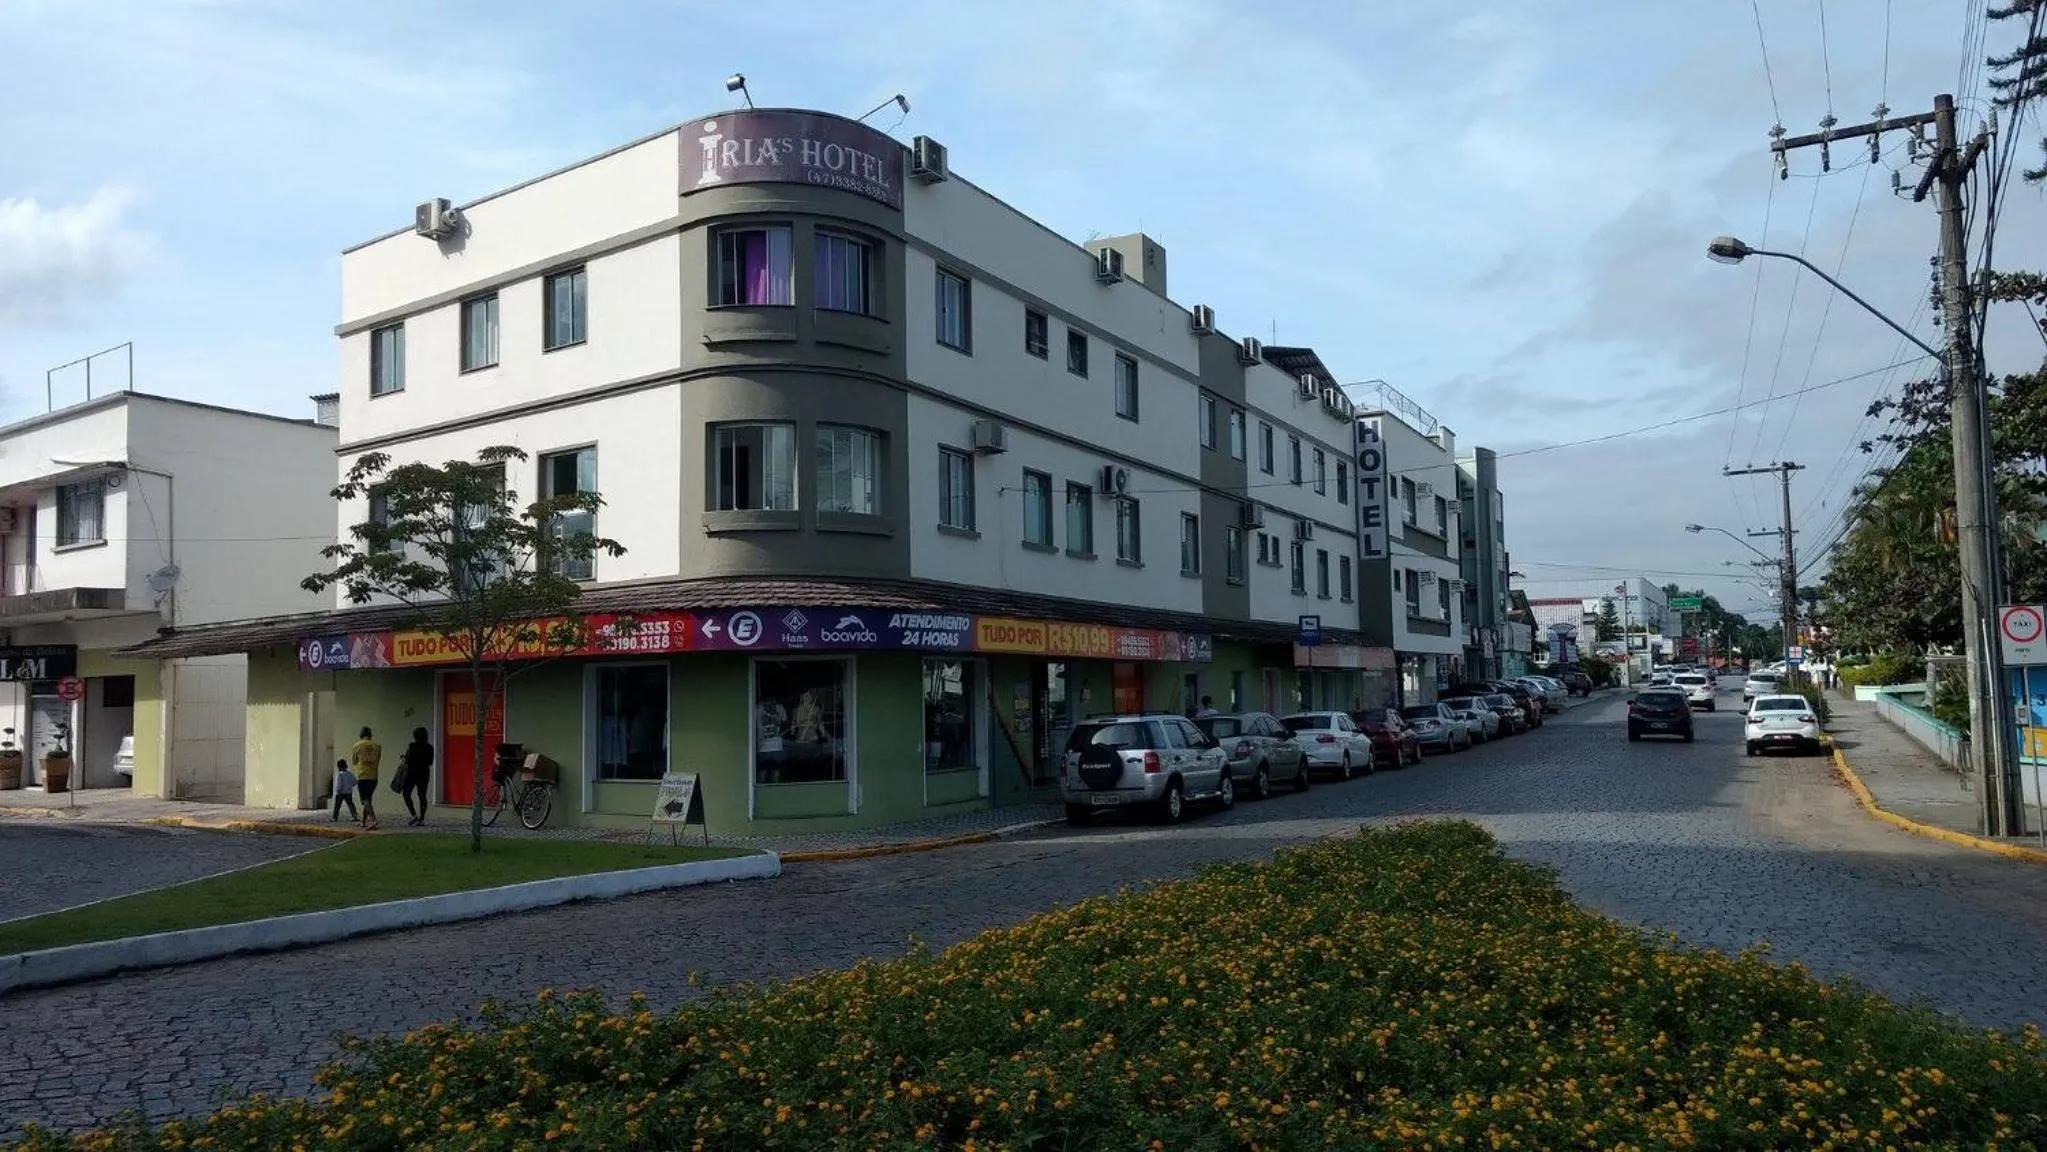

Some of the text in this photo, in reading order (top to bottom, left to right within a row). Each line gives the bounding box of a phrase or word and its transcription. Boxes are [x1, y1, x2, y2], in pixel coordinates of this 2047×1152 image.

[802, 139, 890, 188] HOTEL
[1358, 420, 1382, 556] HOTEL
[888, 613, 970, 630] ATENDIMENTO
[821, 628, 877, 643] boavida
[901, 630, 959, 646] 24 HORAS
[982, 624, 1017, 644] TUDO
[1018, 627, 1043, 644] POR
[398, 638, 436, 657] TUDO
[440, 634, 471, 653] POR
[449, 701, 475, 725] TUDO
